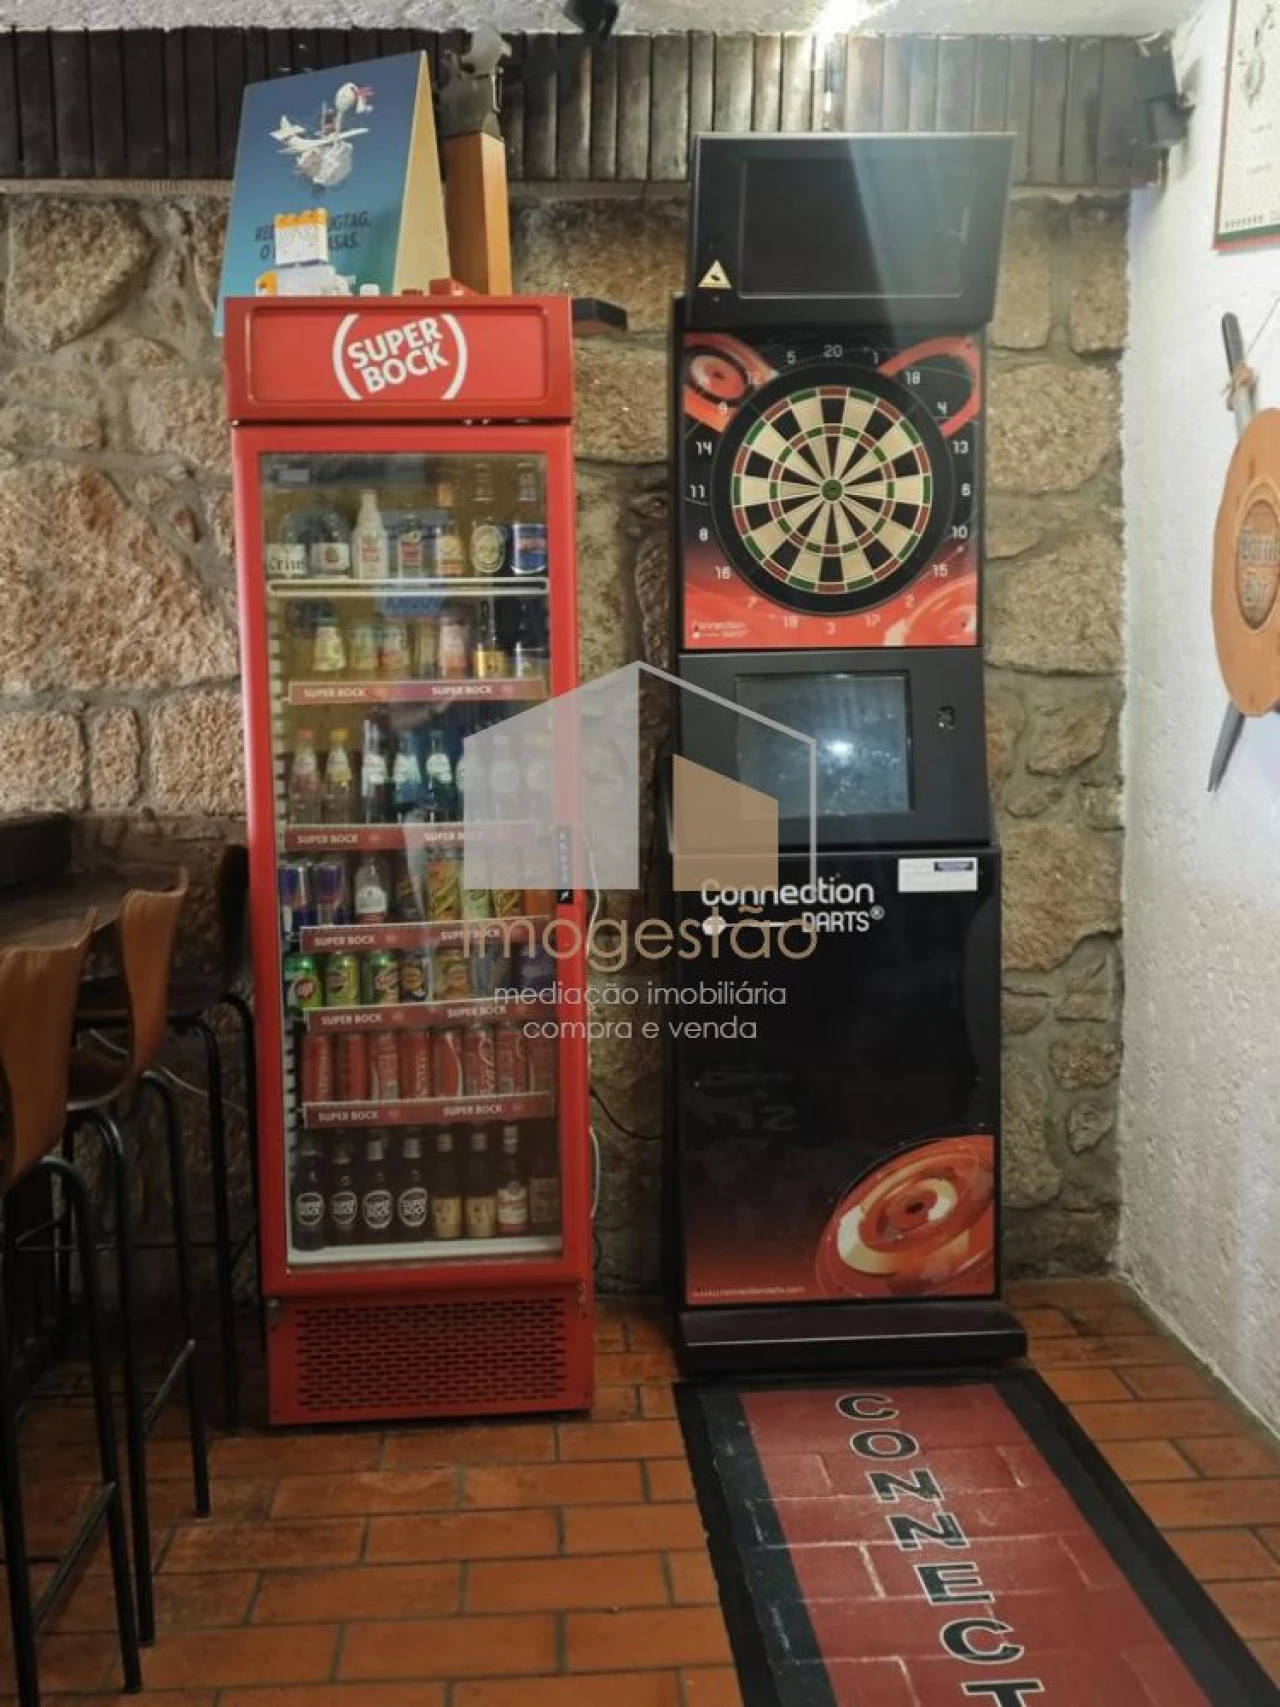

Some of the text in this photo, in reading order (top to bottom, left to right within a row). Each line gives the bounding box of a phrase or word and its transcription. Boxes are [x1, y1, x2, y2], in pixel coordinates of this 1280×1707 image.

[347, 317, 444, 369] SUPER
[823, 345, 843, 357] 20
[786, 352, 796, 364] 5
[872, 352, 879, 363] 1
[360, 342, 449, 394] BOCK
[905, 372, 920, 384] 18
[937, 402, 947, 414] 4
[696, 442, 712, 455] 14
[953, 441, 969, 454] 13
[690, 485, 705, 497] 11
[699, 529, 709, 541] 8
[952, 526, 969, 539] 10
[715, 567, 731, 579] 16
[933, 565, 948, 577] 15
[826, 622, 836, 635] 3
[701, 878, 875, 906] Connection
[836, 1394, 1045, 1707] CONNECT
